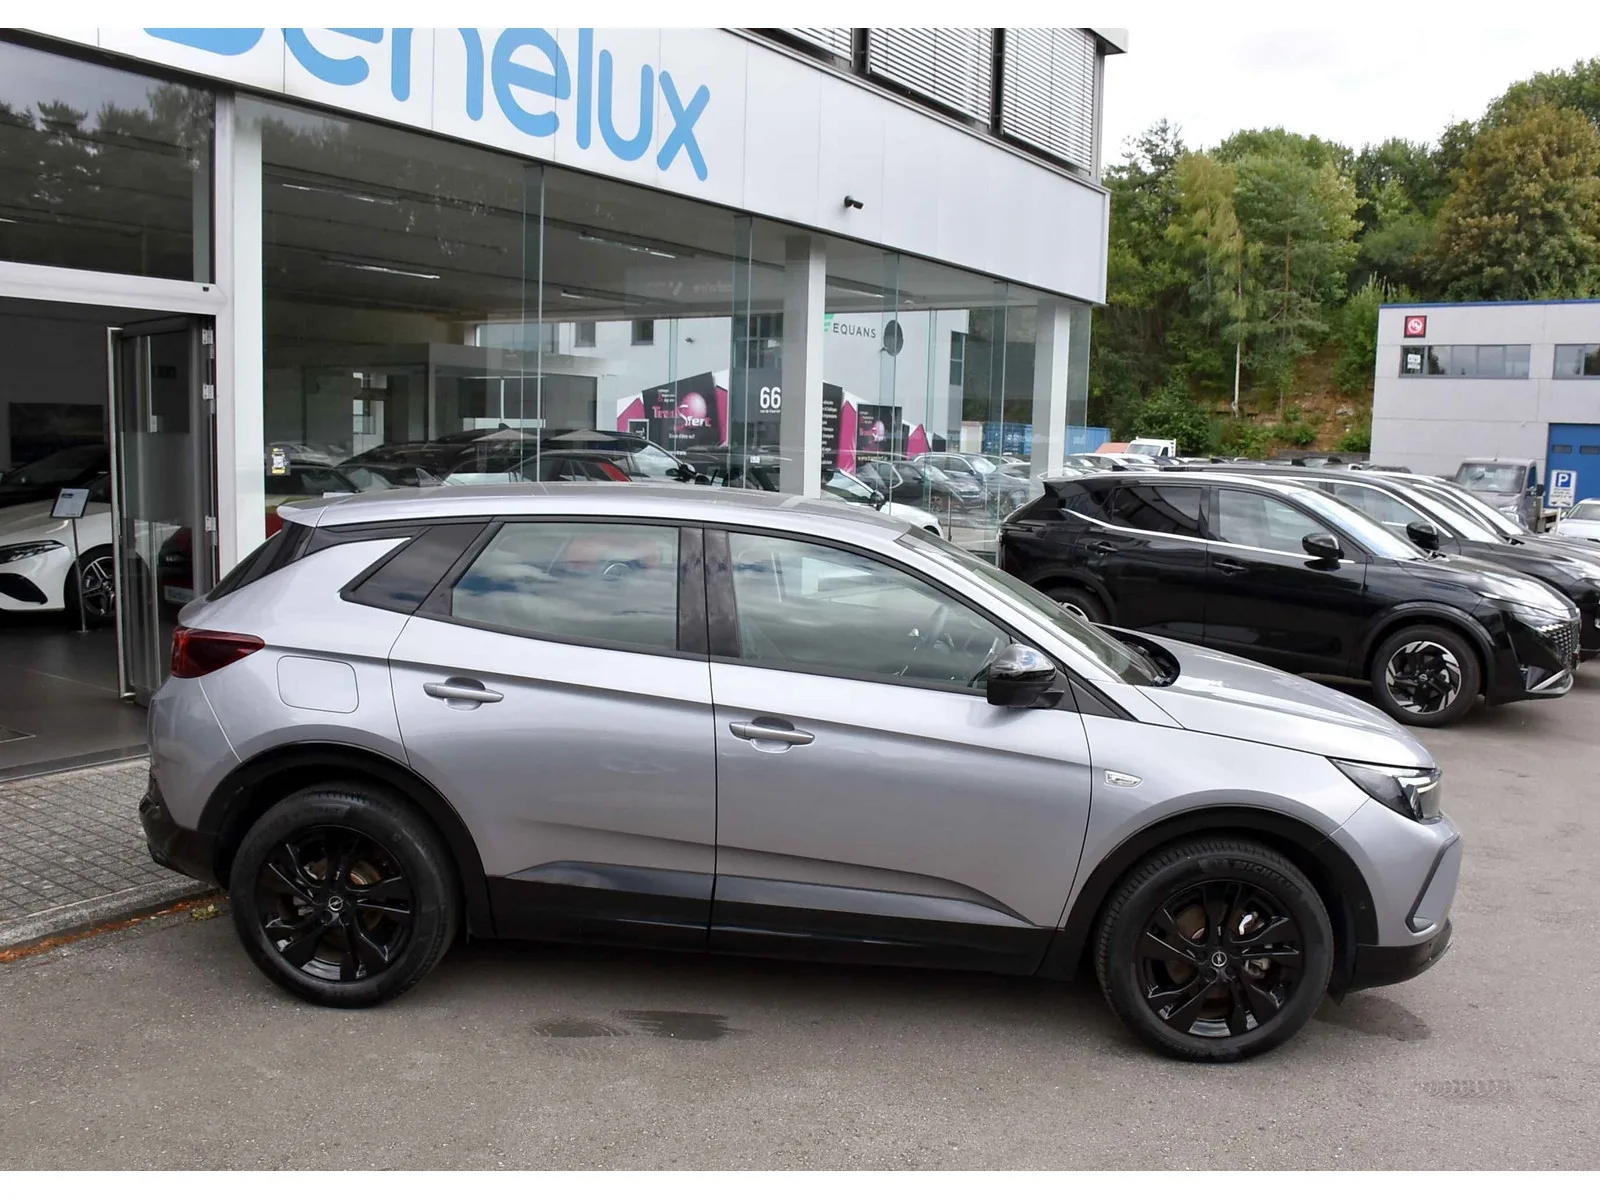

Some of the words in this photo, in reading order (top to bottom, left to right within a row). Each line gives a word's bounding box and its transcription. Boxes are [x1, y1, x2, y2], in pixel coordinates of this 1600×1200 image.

[833, 322, 877, 339] EQUANS
[760, 386, 781, 409] 66
[1557, 473, 1568, 486] P
